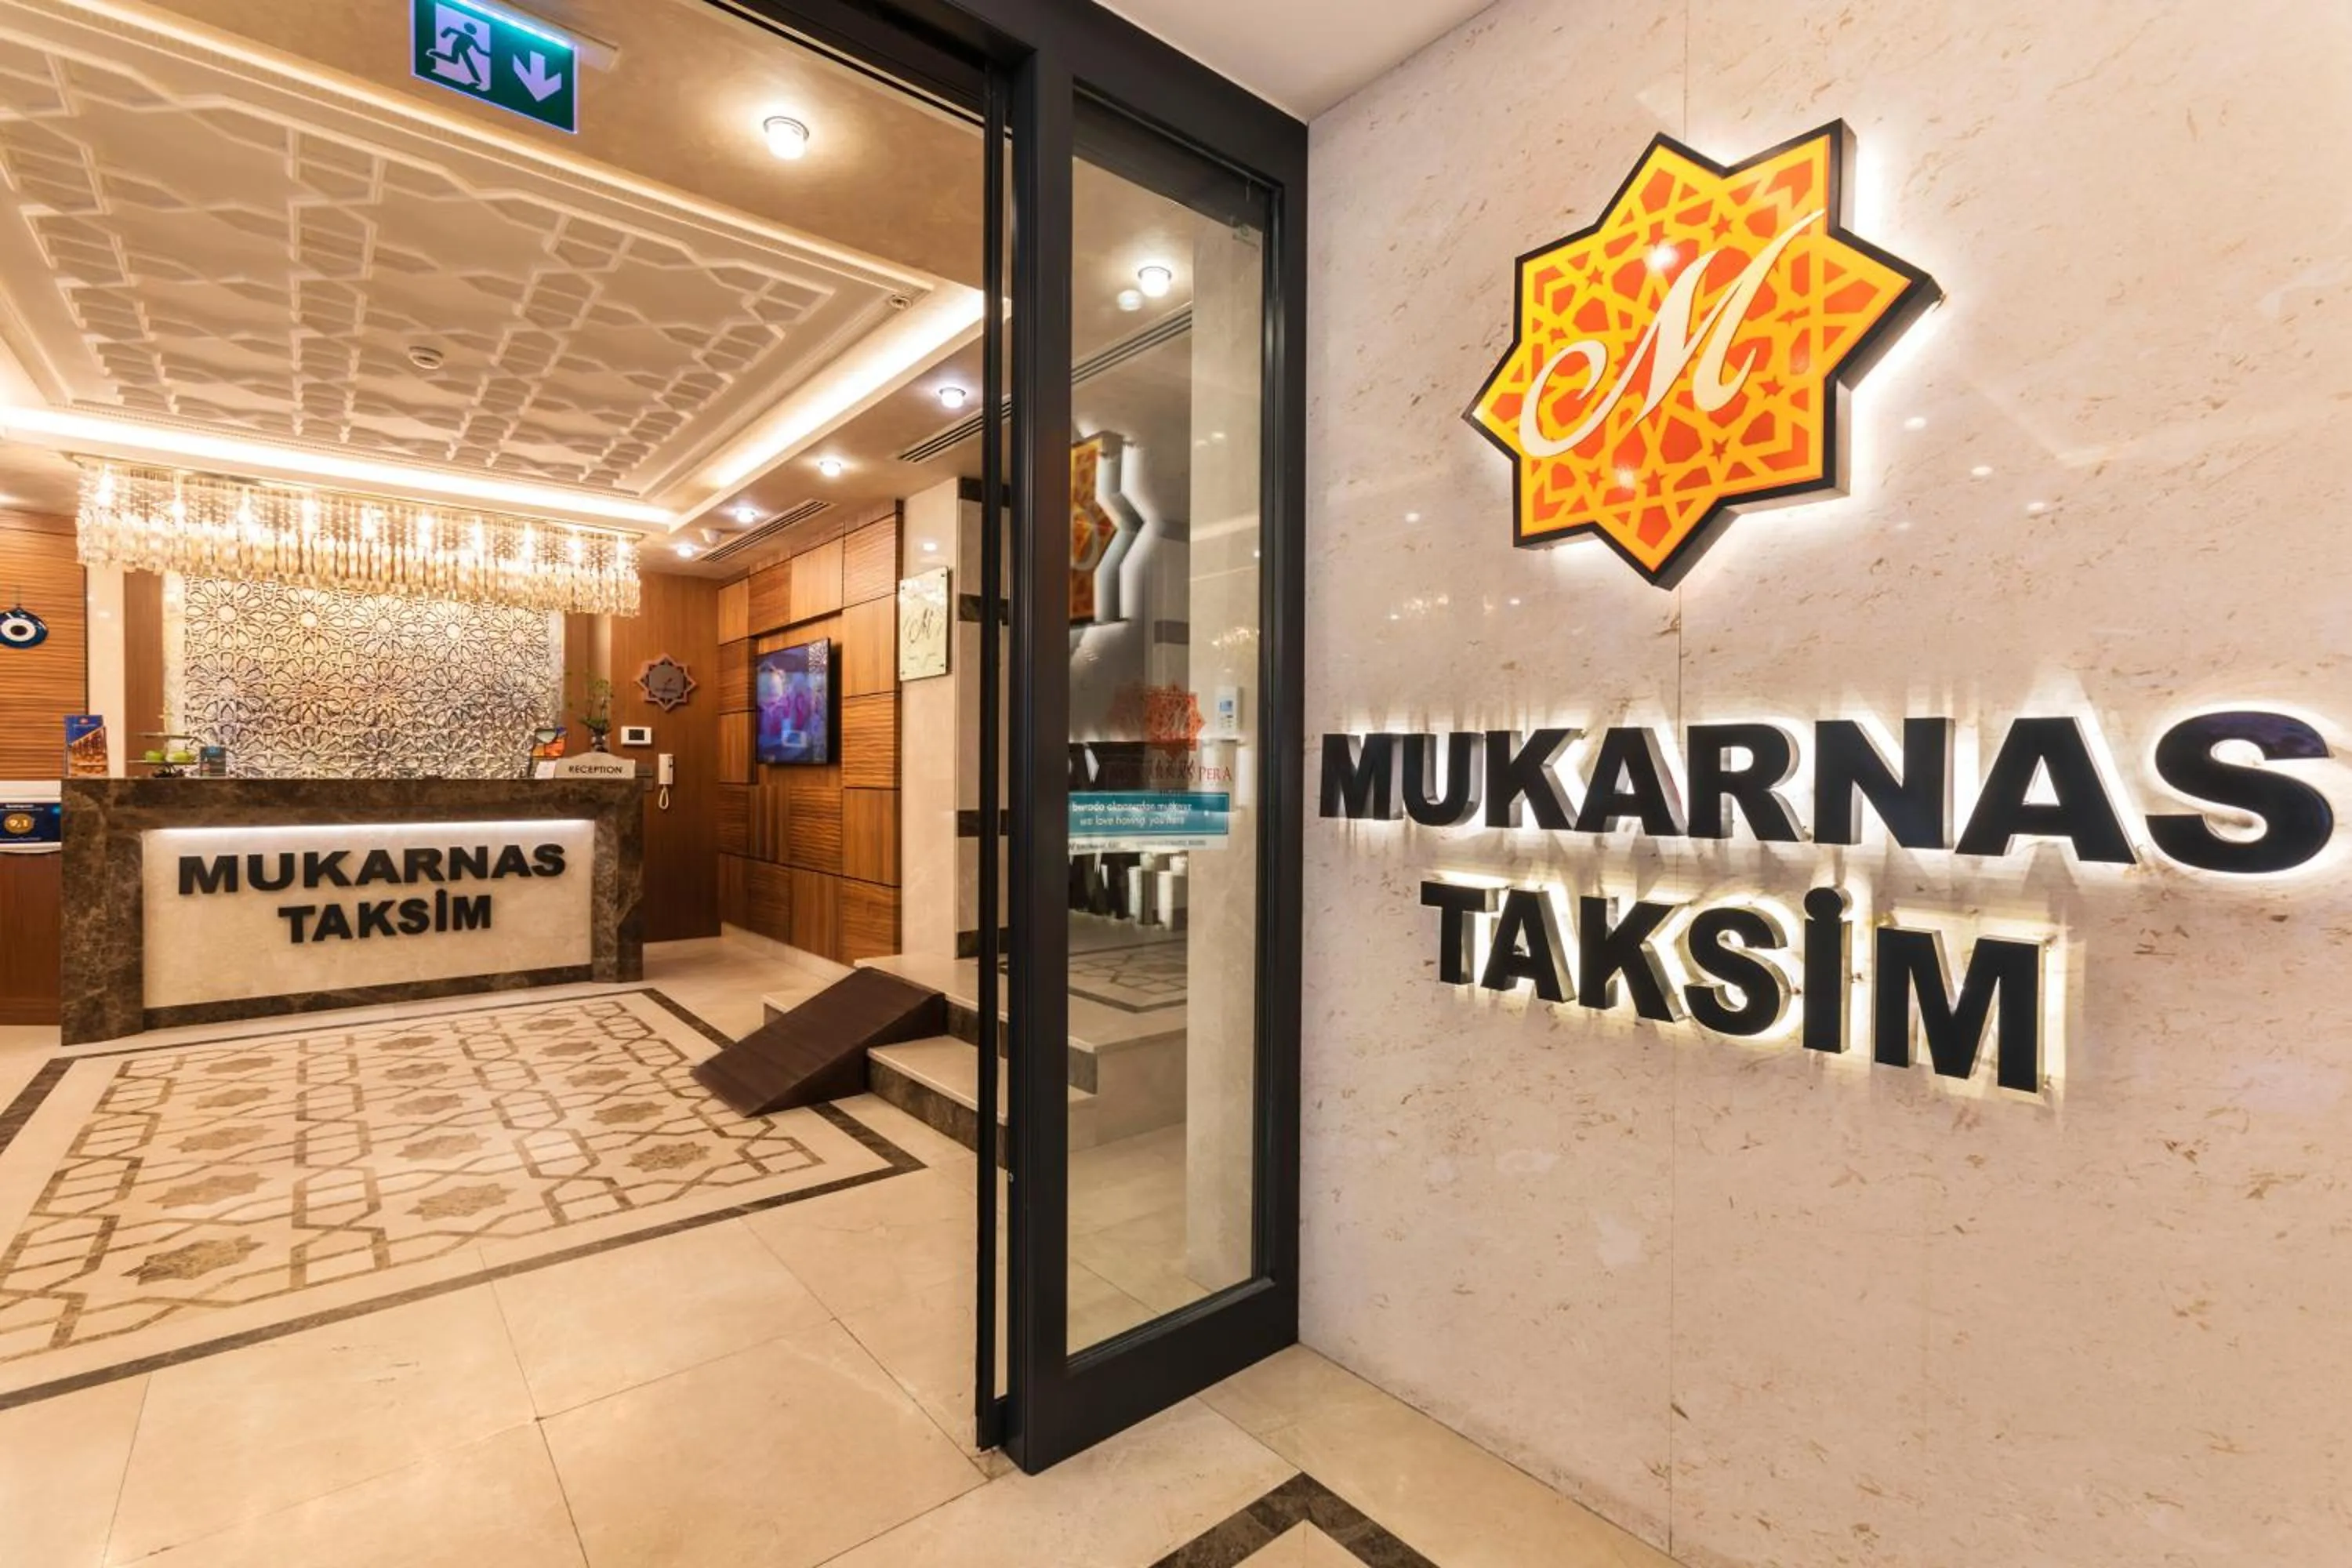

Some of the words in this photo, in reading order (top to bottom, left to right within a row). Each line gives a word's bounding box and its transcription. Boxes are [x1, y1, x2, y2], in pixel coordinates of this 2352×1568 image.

[1519, 207, 1826, 458] M
[568, 765, 622, 774] RECEPTION
[1319, 710, 2335, 873] MUKARNAS
[178, 844, 566, 895] MUKARNAS
[278, 889, 492, 943] TAKSİM
[1419, 880, 2045, 1093] TAKSİM
